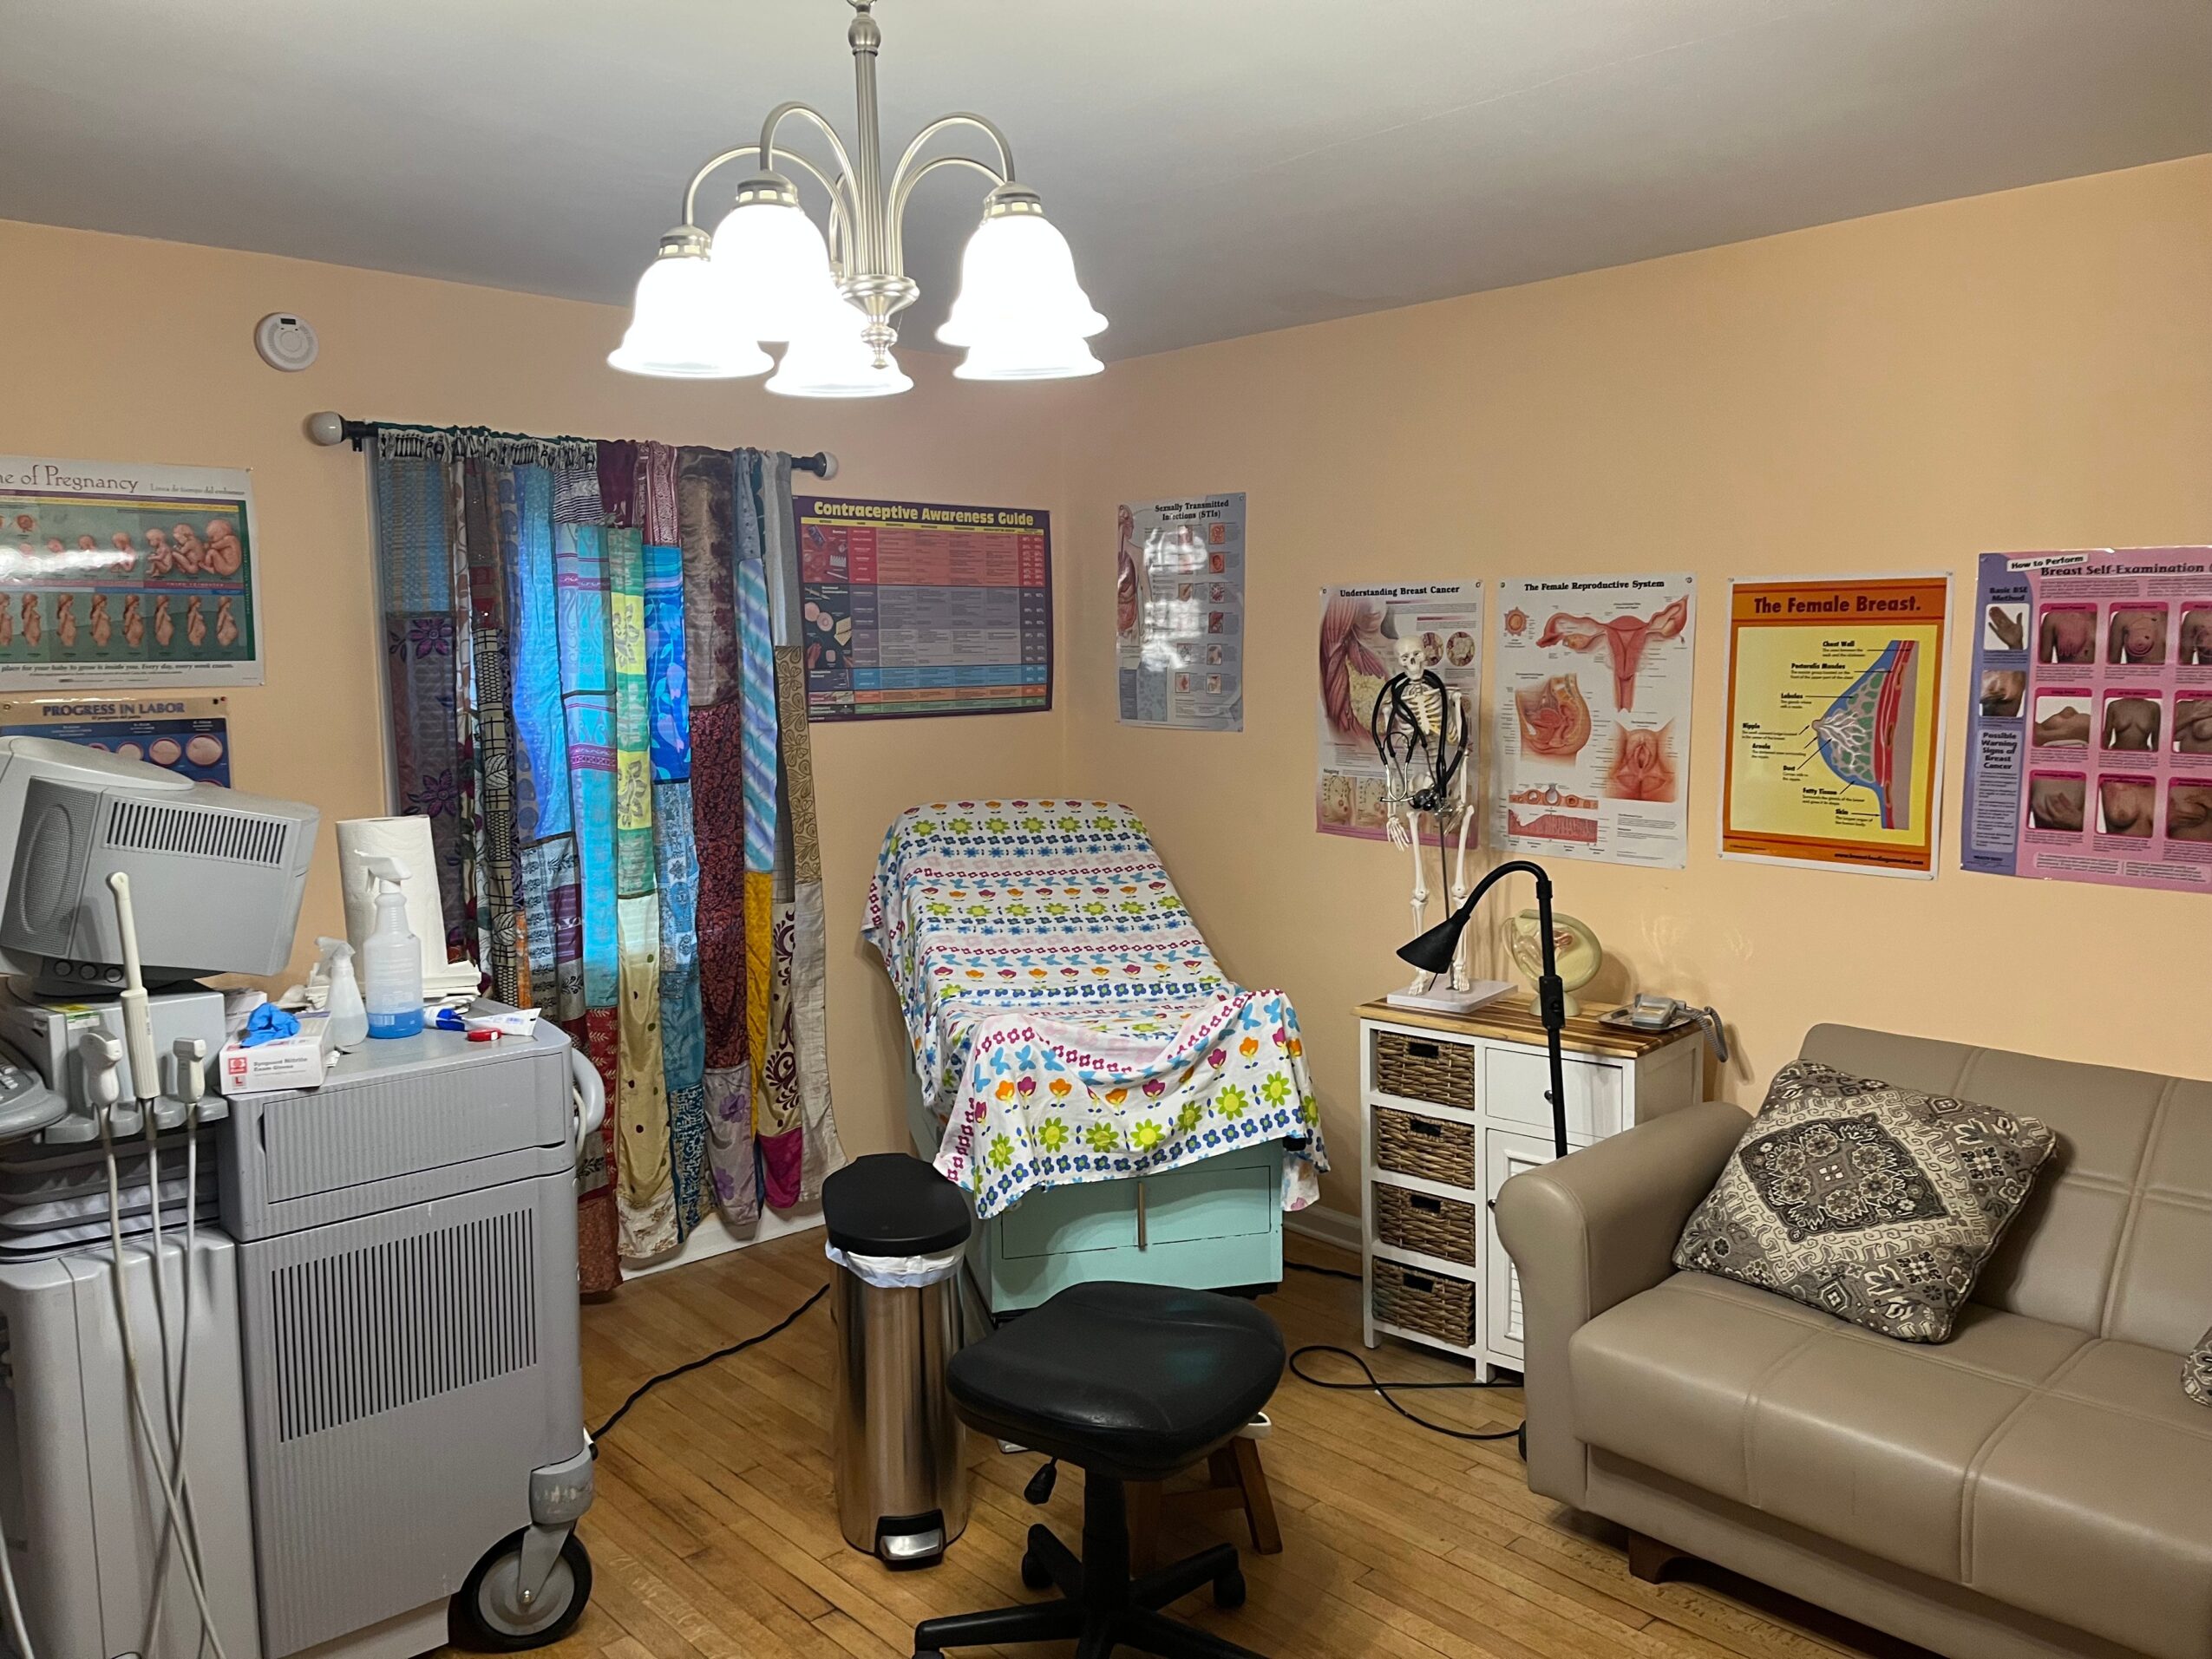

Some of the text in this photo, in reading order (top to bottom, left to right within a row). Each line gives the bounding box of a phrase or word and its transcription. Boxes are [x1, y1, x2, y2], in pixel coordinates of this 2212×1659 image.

[21, 465, 39, 485] of
[45, 465, 138, 493] Pregnancy
[1155, 500, 1229, 513] Sexually Transmitted
[814, 501, 918, 520] Contraceptive
[921, 507, 994, 524] Awareness
[998, 512, 1034, 526] Guide
[1198, 510, 1221, 519] (STIs)
[2045, 556, 2084, 565] Perform
[2041, 566, 2082, 576] Breast
[2086, 563, 2204, 574] Self-Examination
[1340, 588, 1397, 597] Understanding
[1430, 585, 1460, 594] Cancer
[1571, 581, 1629, 591] Reproductive
[1632, 580, 1665, 590] System
[1754, 595, 1921, 613] The Female Breast.
[43, 702, 185, 716] PROGRESS IN LABOR
[1981, 740, 2018, 748] Warning
